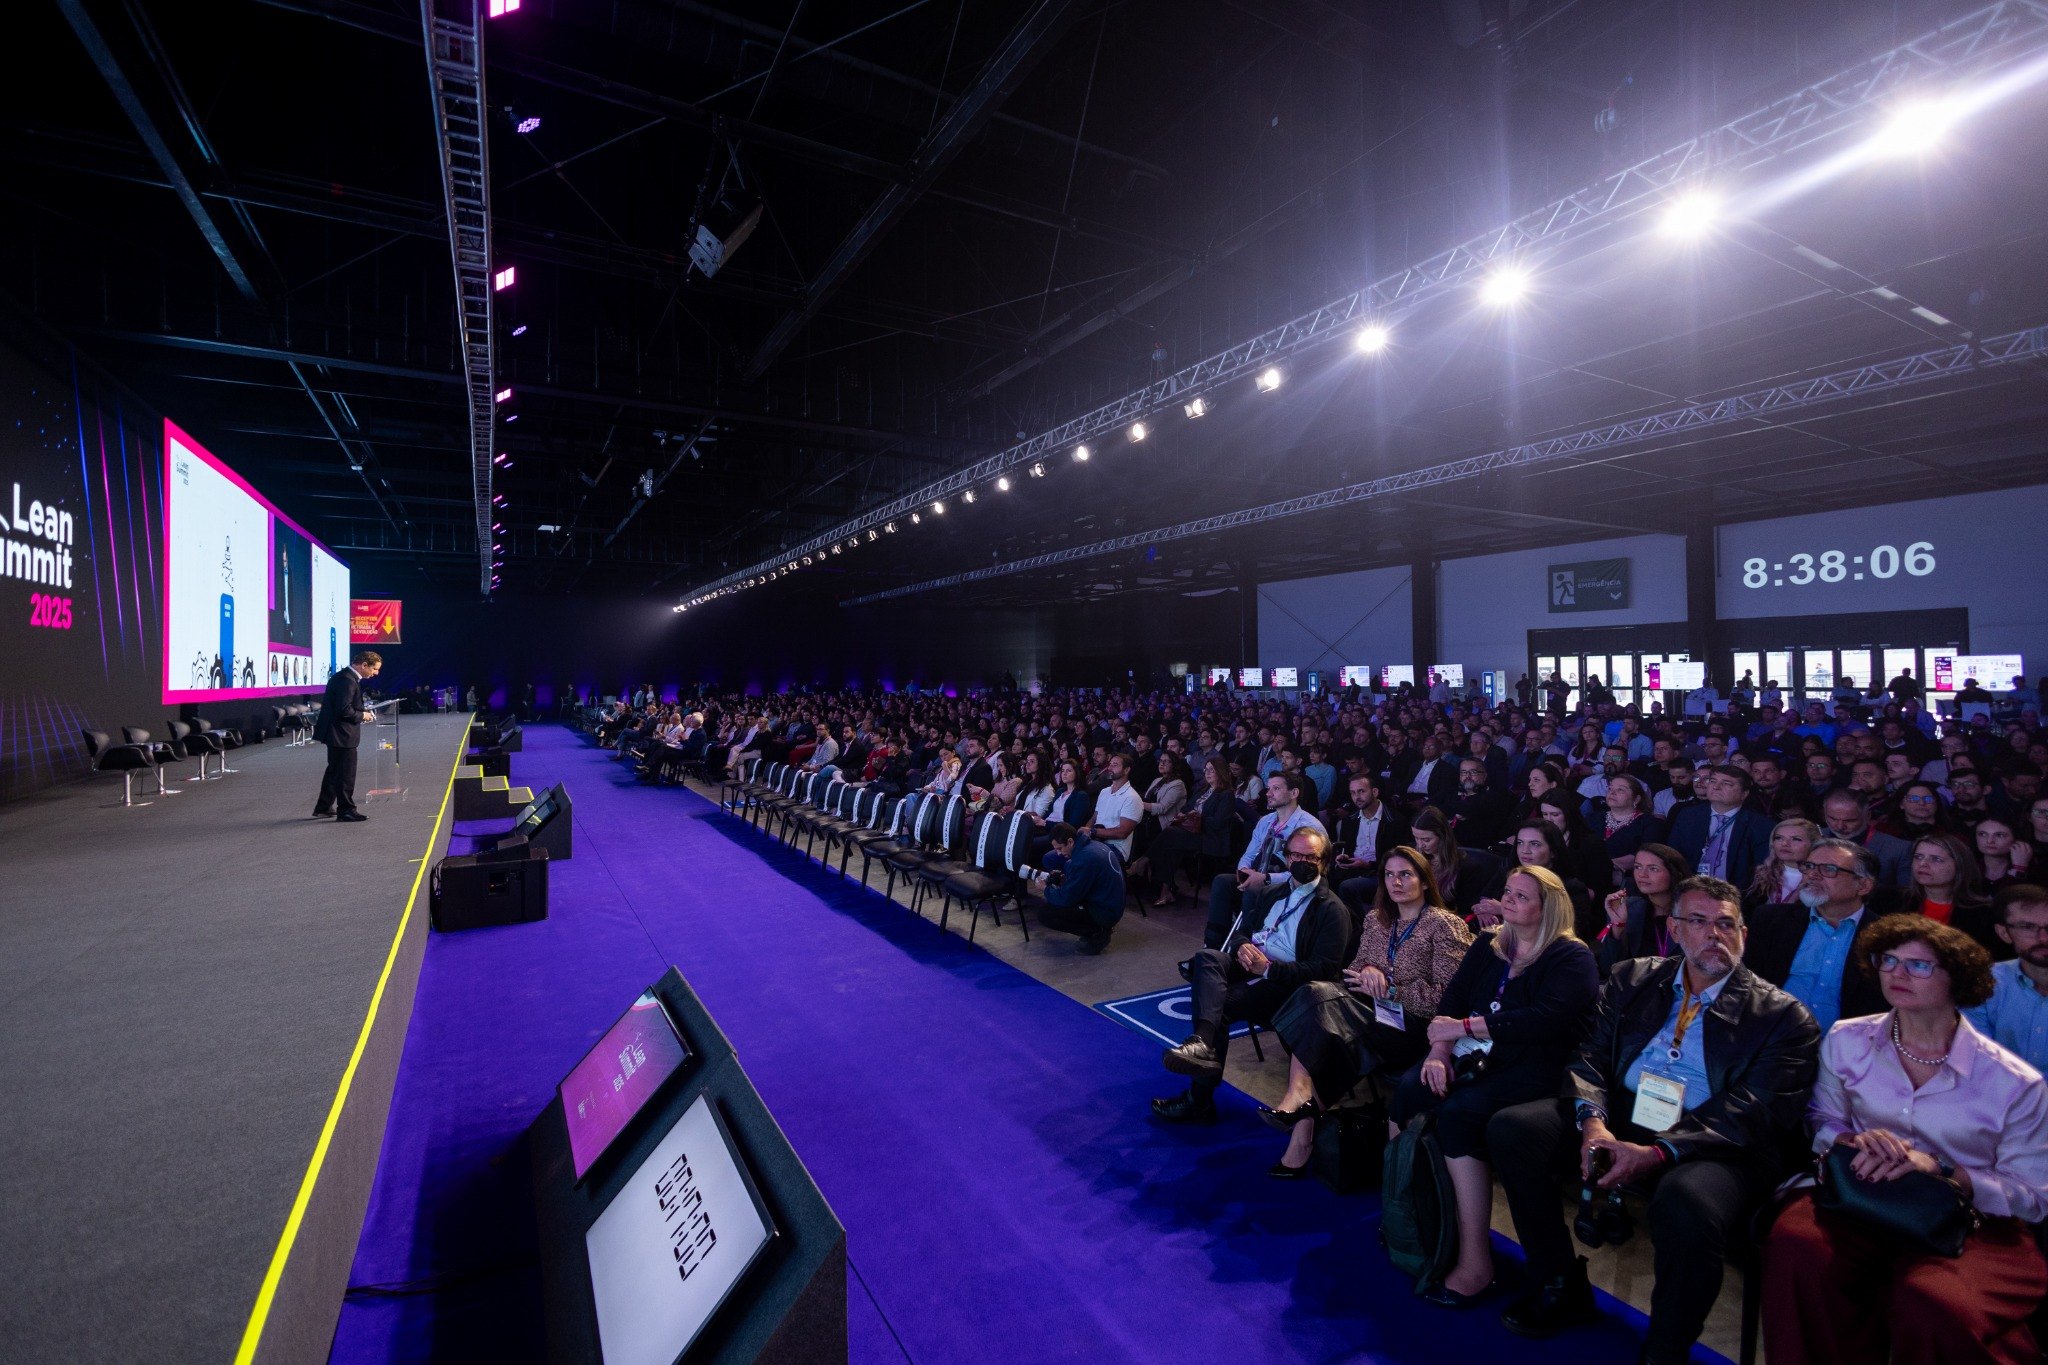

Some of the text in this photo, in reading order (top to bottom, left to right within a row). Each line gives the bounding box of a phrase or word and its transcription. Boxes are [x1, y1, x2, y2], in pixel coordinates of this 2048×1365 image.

[13, 482, 73, 545] Lean
[1742, 541, 1937, 588] 8:38:06
[30, 591, 73, 629] 2025
